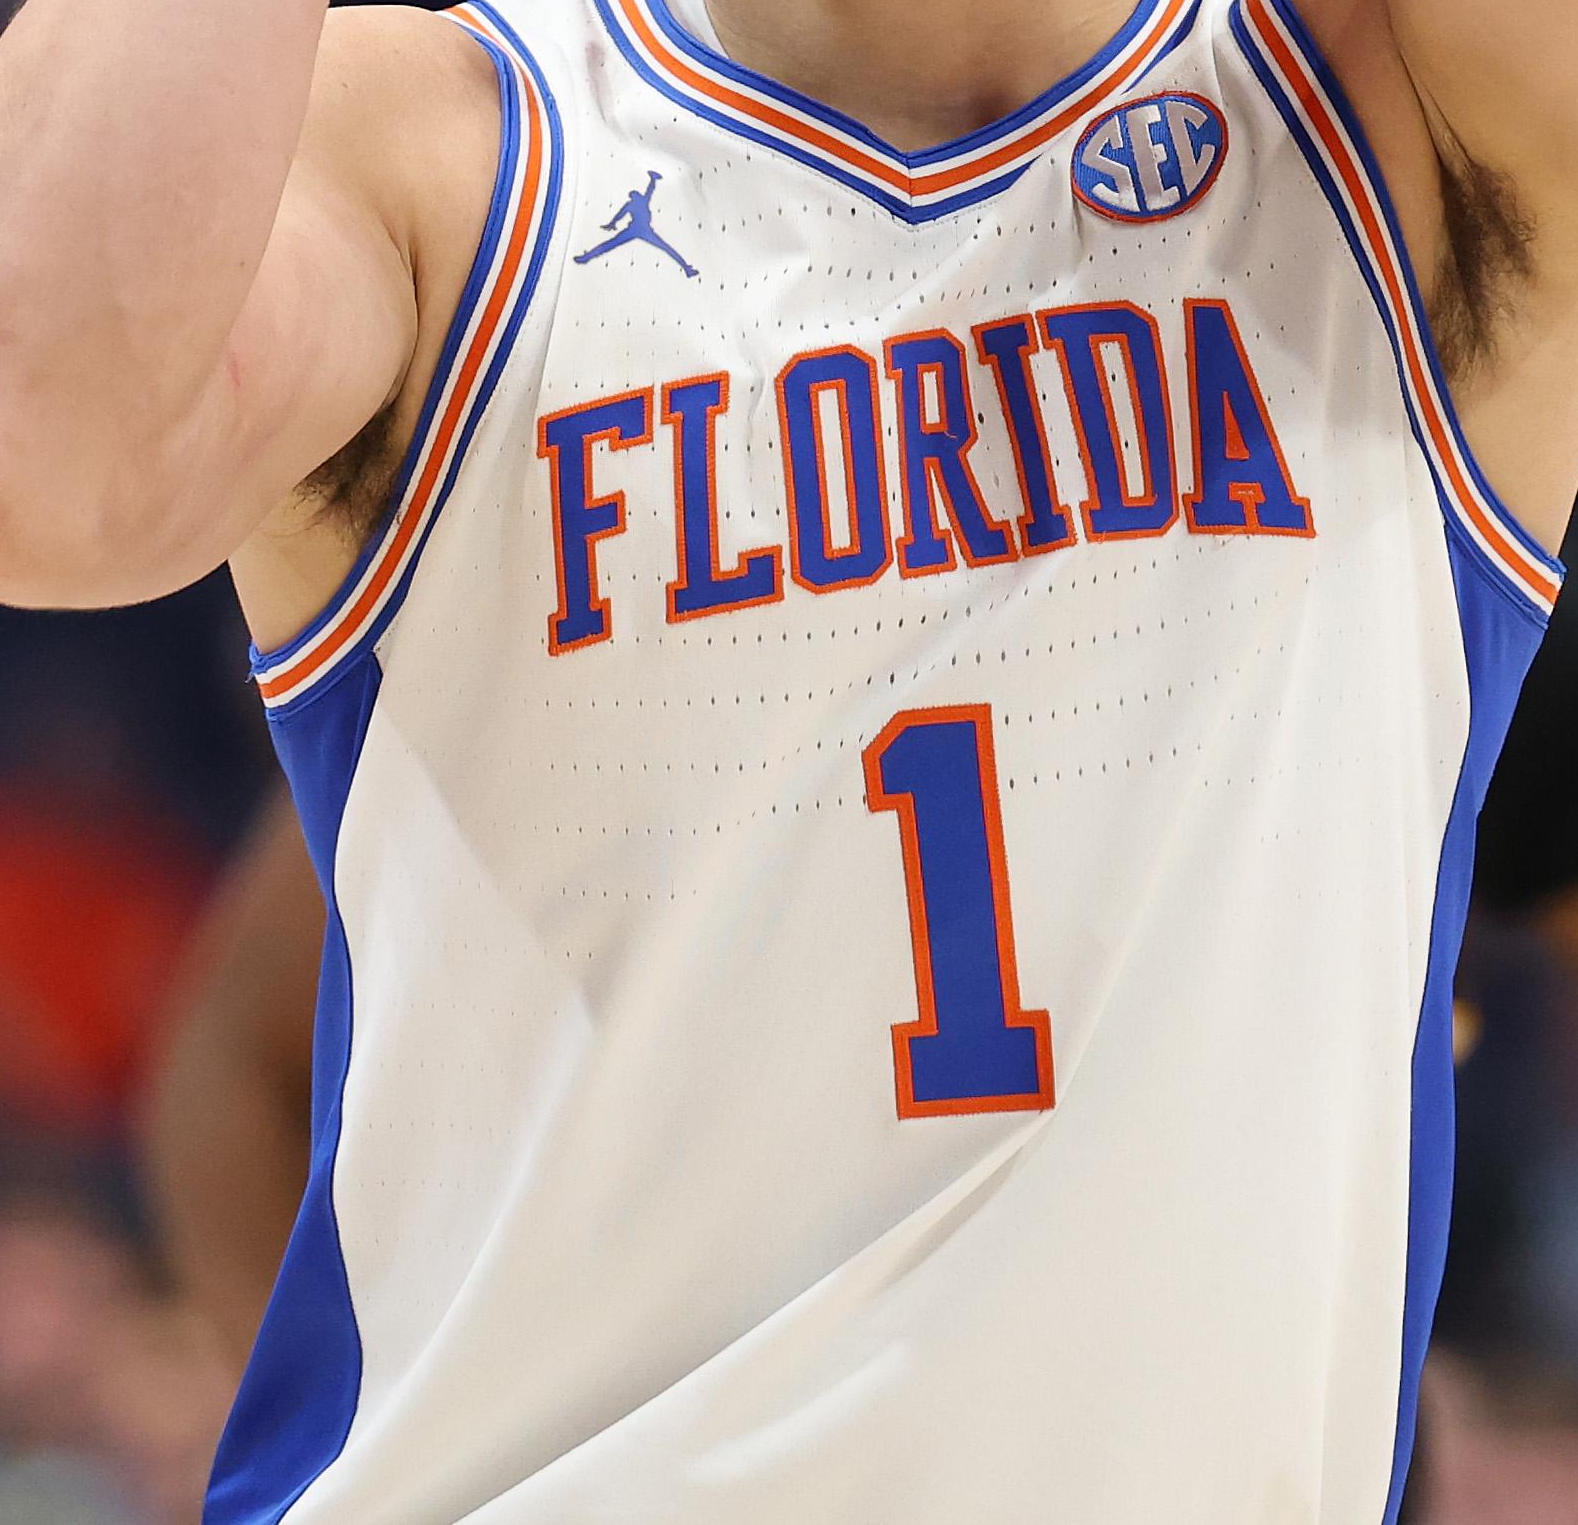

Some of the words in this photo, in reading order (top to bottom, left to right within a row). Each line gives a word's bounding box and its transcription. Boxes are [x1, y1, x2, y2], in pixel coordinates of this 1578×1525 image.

[1082, 100, 1216, 212] SEC
[536, 297, 1316, 657] FLORIDA
[861, 702, 1056, 1121] 1
